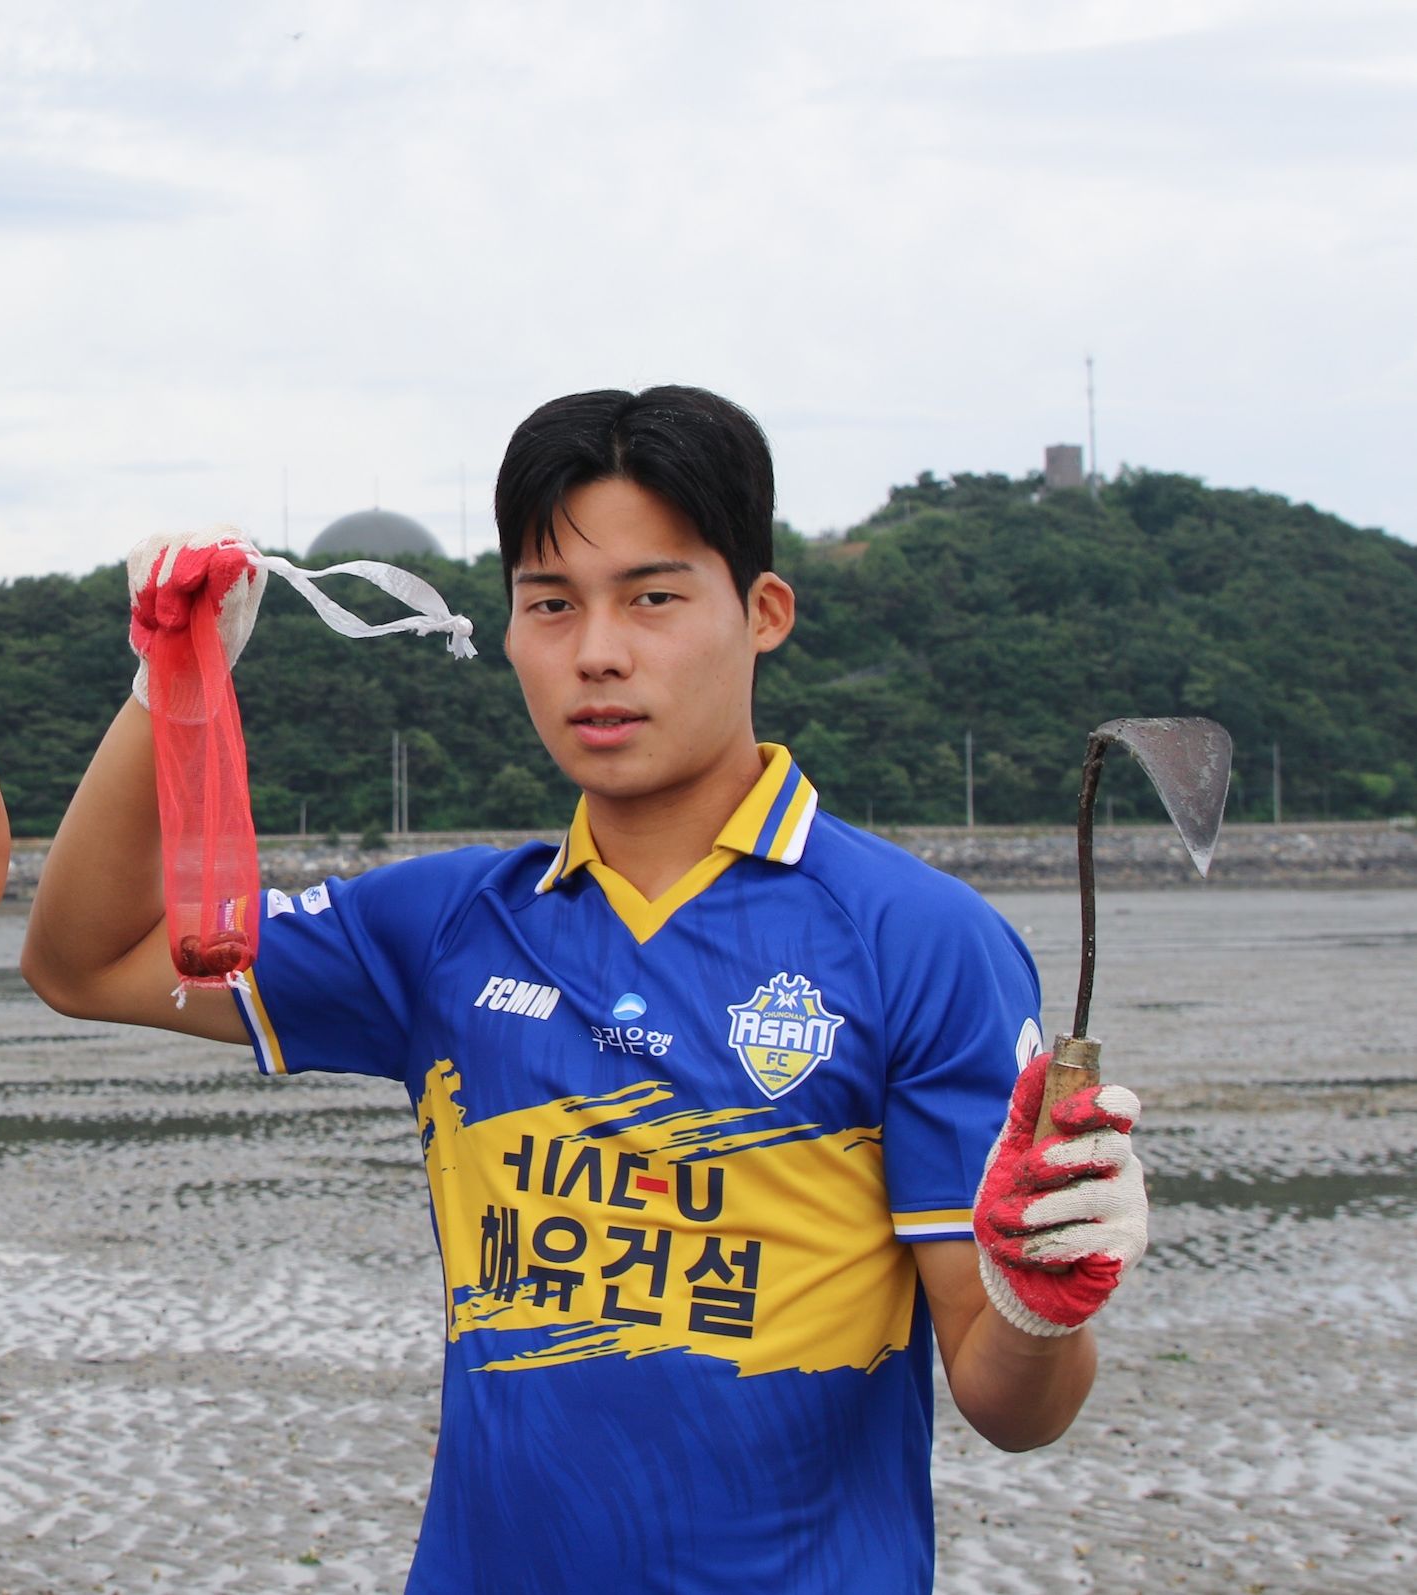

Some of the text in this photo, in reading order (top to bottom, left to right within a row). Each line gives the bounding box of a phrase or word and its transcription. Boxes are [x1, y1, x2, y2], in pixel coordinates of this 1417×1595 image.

[474, 975, 562, 1021] FCMM
[763, 1011, 807, 1022] CHUNGNAM
[591, 1025, 675, 1057] 우리은행
[735, 1011, 833, 1054] ASAN
[766, 1051, 790, 1068] FC
[479, 1204, 762, 1339] 해유건설
